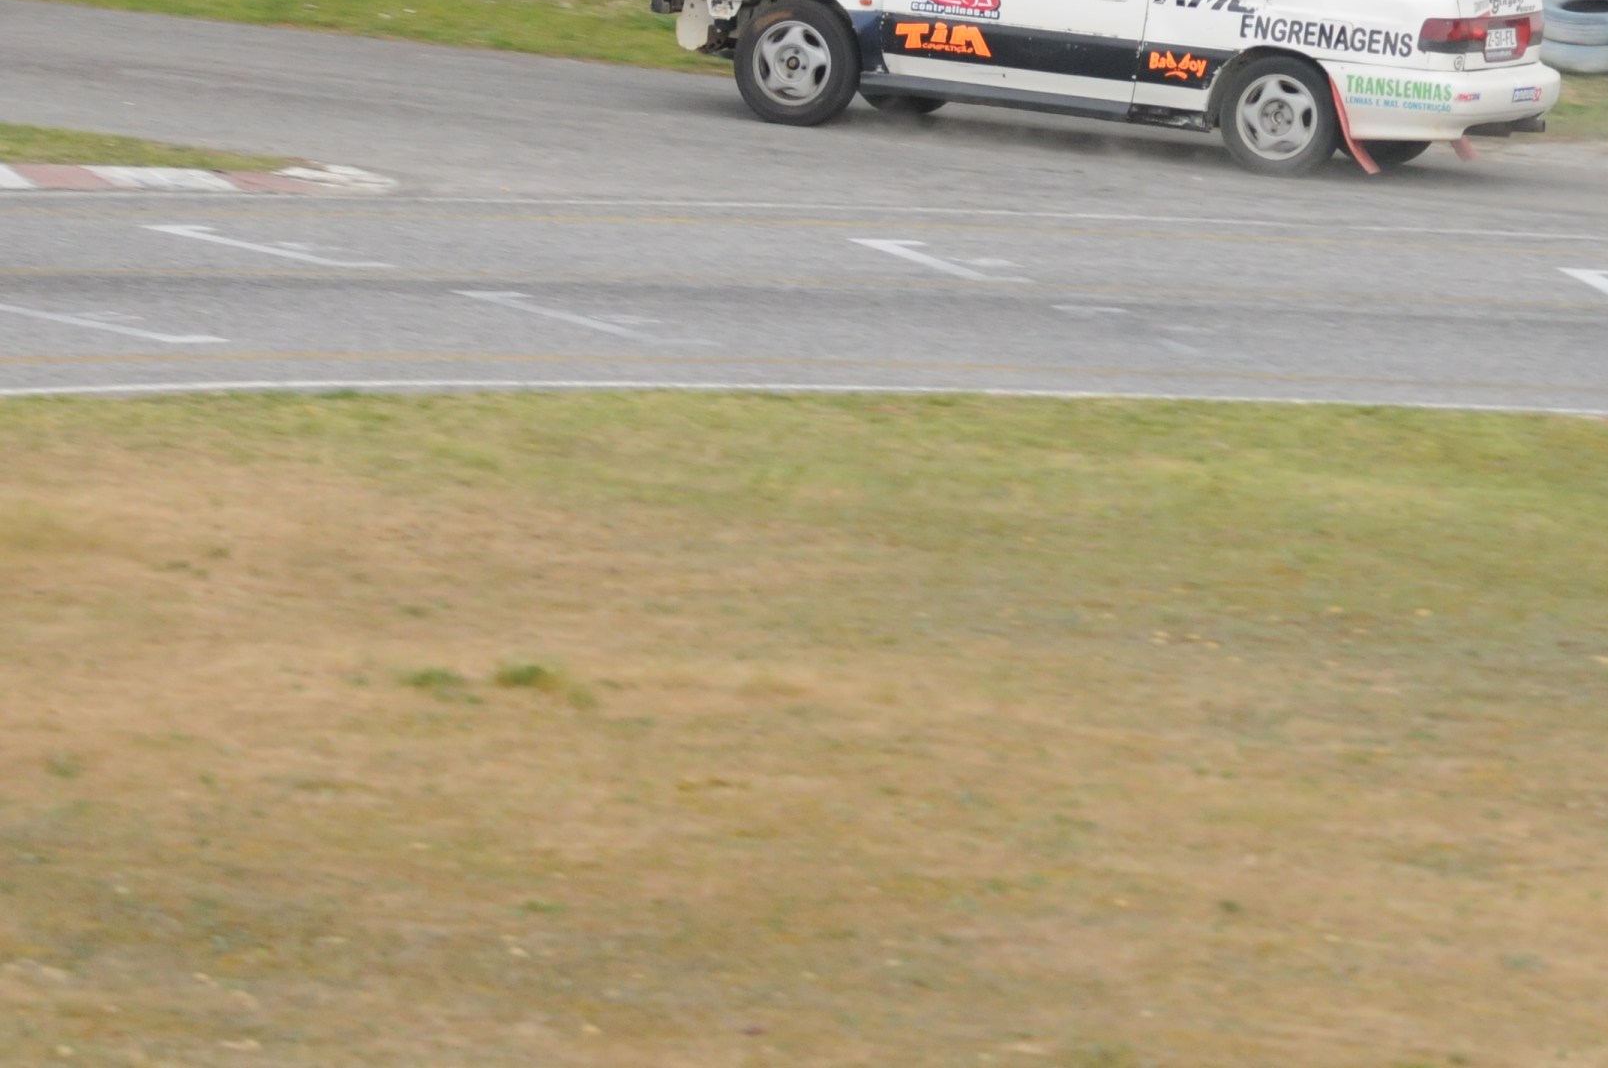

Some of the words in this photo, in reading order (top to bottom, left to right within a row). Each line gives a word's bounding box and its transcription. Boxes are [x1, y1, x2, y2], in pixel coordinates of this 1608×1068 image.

[1239, 14, 1413, 58] ENGRENAGENS
[1345, 95, 1373, 106] LENHAS
[1346, 74, 1453, 102] TRANSLENHAS
